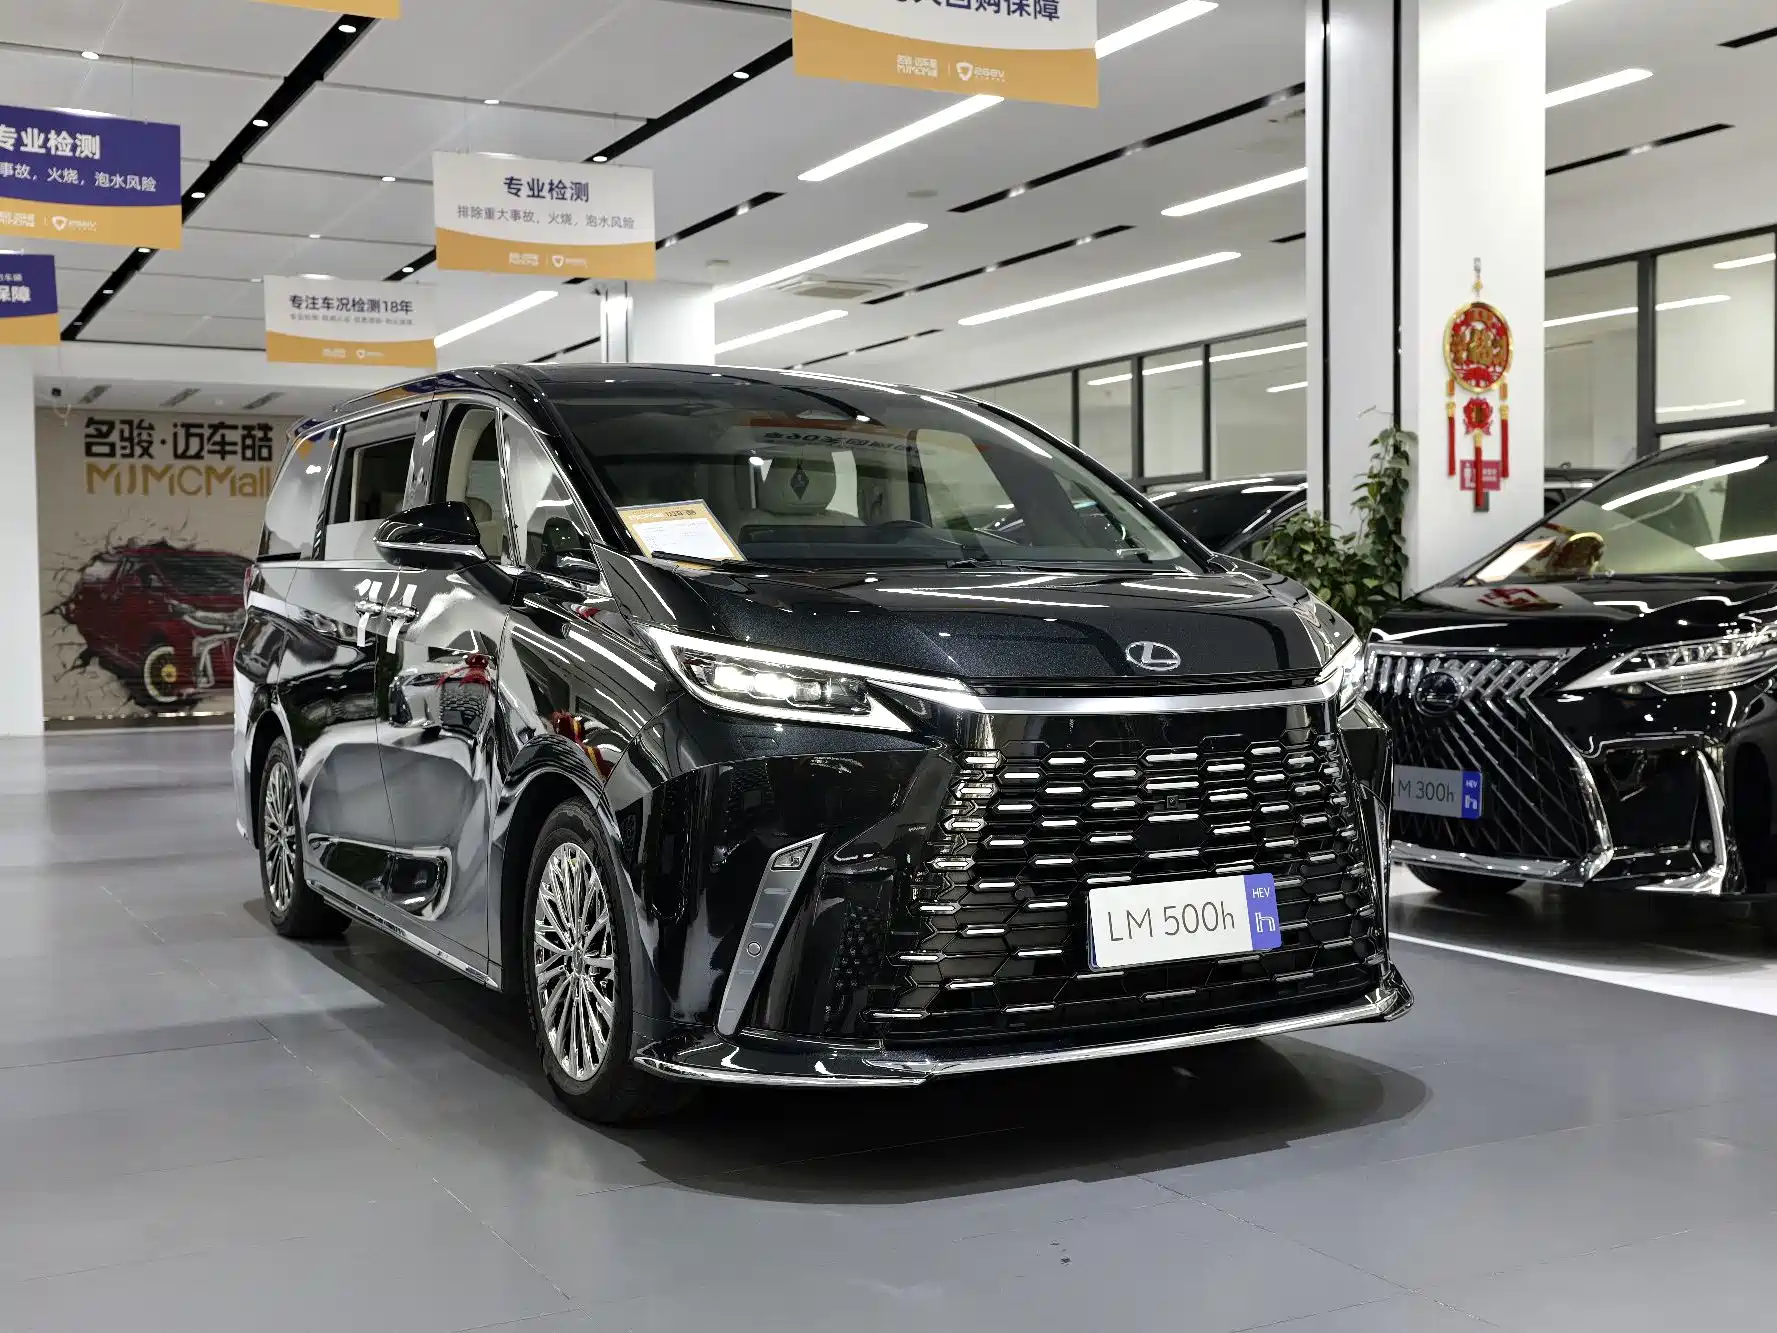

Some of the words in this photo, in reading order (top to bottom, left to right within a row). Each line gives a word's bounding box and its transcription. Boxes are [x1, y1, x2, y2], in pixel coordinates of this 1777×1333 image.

[0, 124, 101, 160] 专业检测
[503, 175, 590, 204] 专业检测
[289, 294, 414, 315] 专注车况检测18年
[85, 461, 272, 497] MJMCMall
[1393, 779, 1411, 799] M
[1415, 780, 1456, 803] 300h
[1251, 887, 1271, 898] HEV
[1107, 907, 1154, 942] LM
[1163, 900, 1236, 936] 500h
